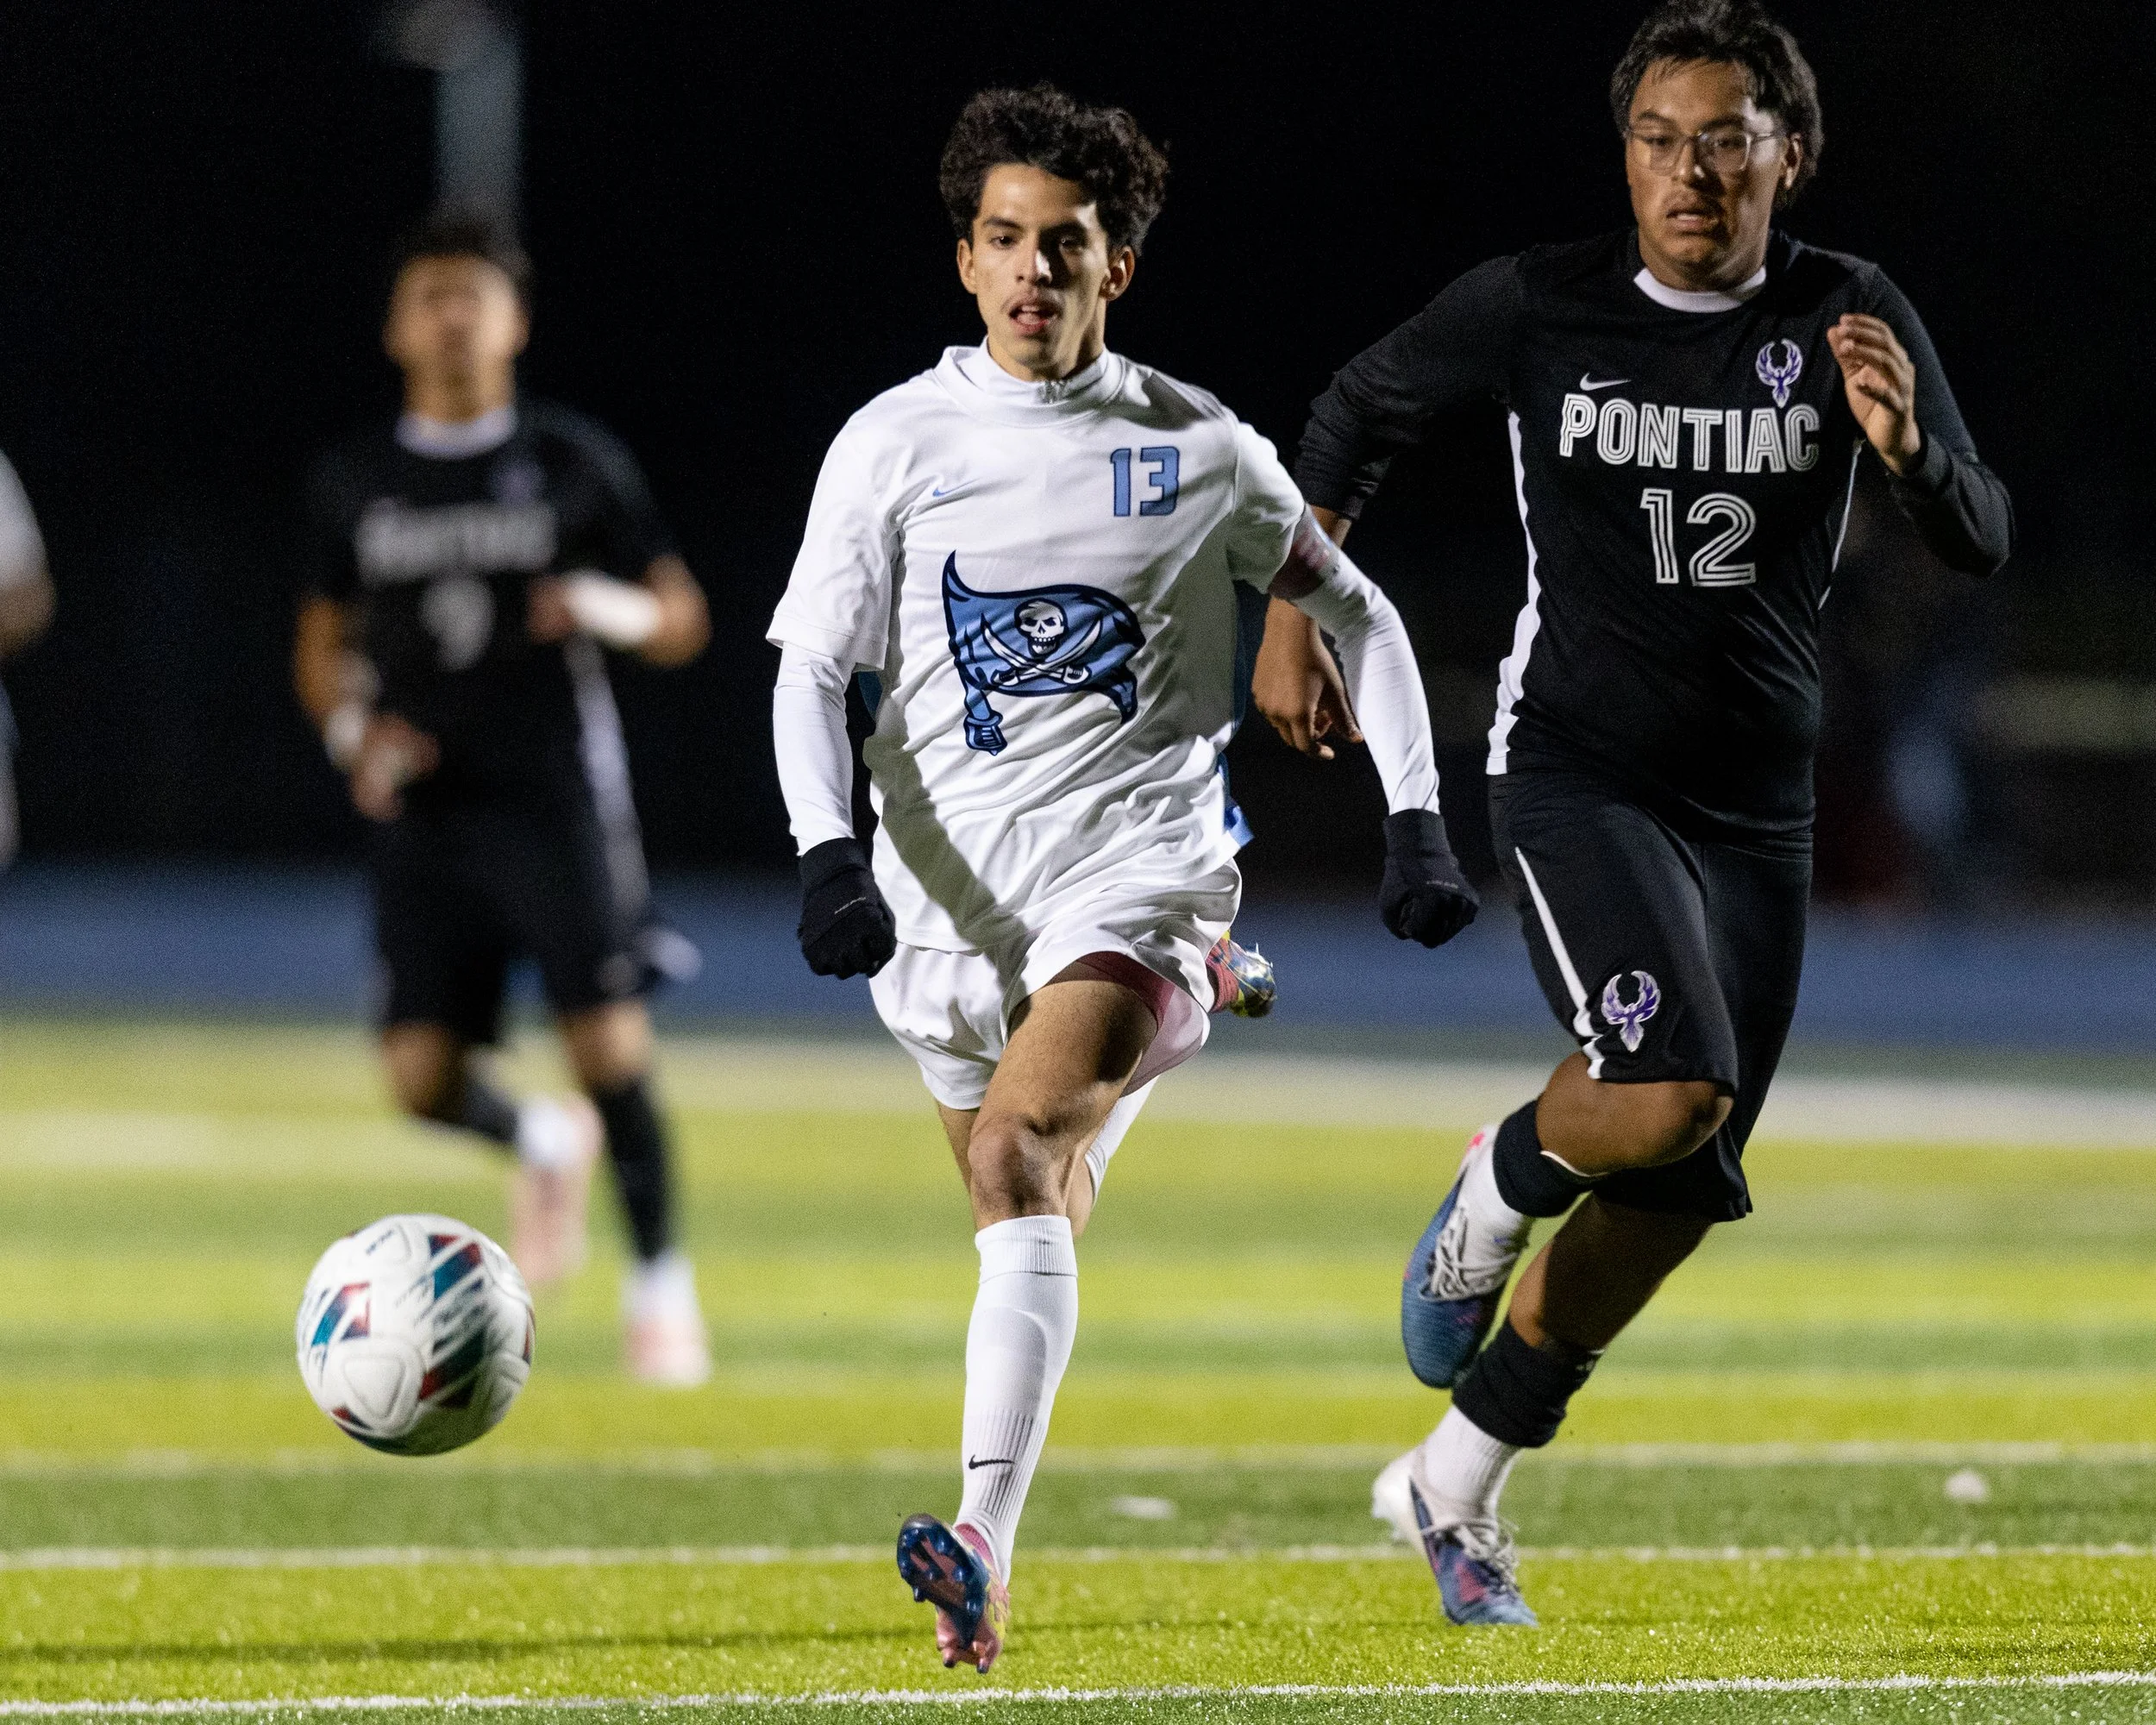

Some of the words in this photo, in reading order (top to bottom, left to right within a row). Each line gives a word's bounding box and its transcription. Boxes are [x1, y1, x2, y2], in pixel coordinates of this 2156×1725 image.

[1559, 393, 1820, 473] PONTIAC
[1110, 446, 1180, 517] 13
[1639, 487, 1757, 587] 12
